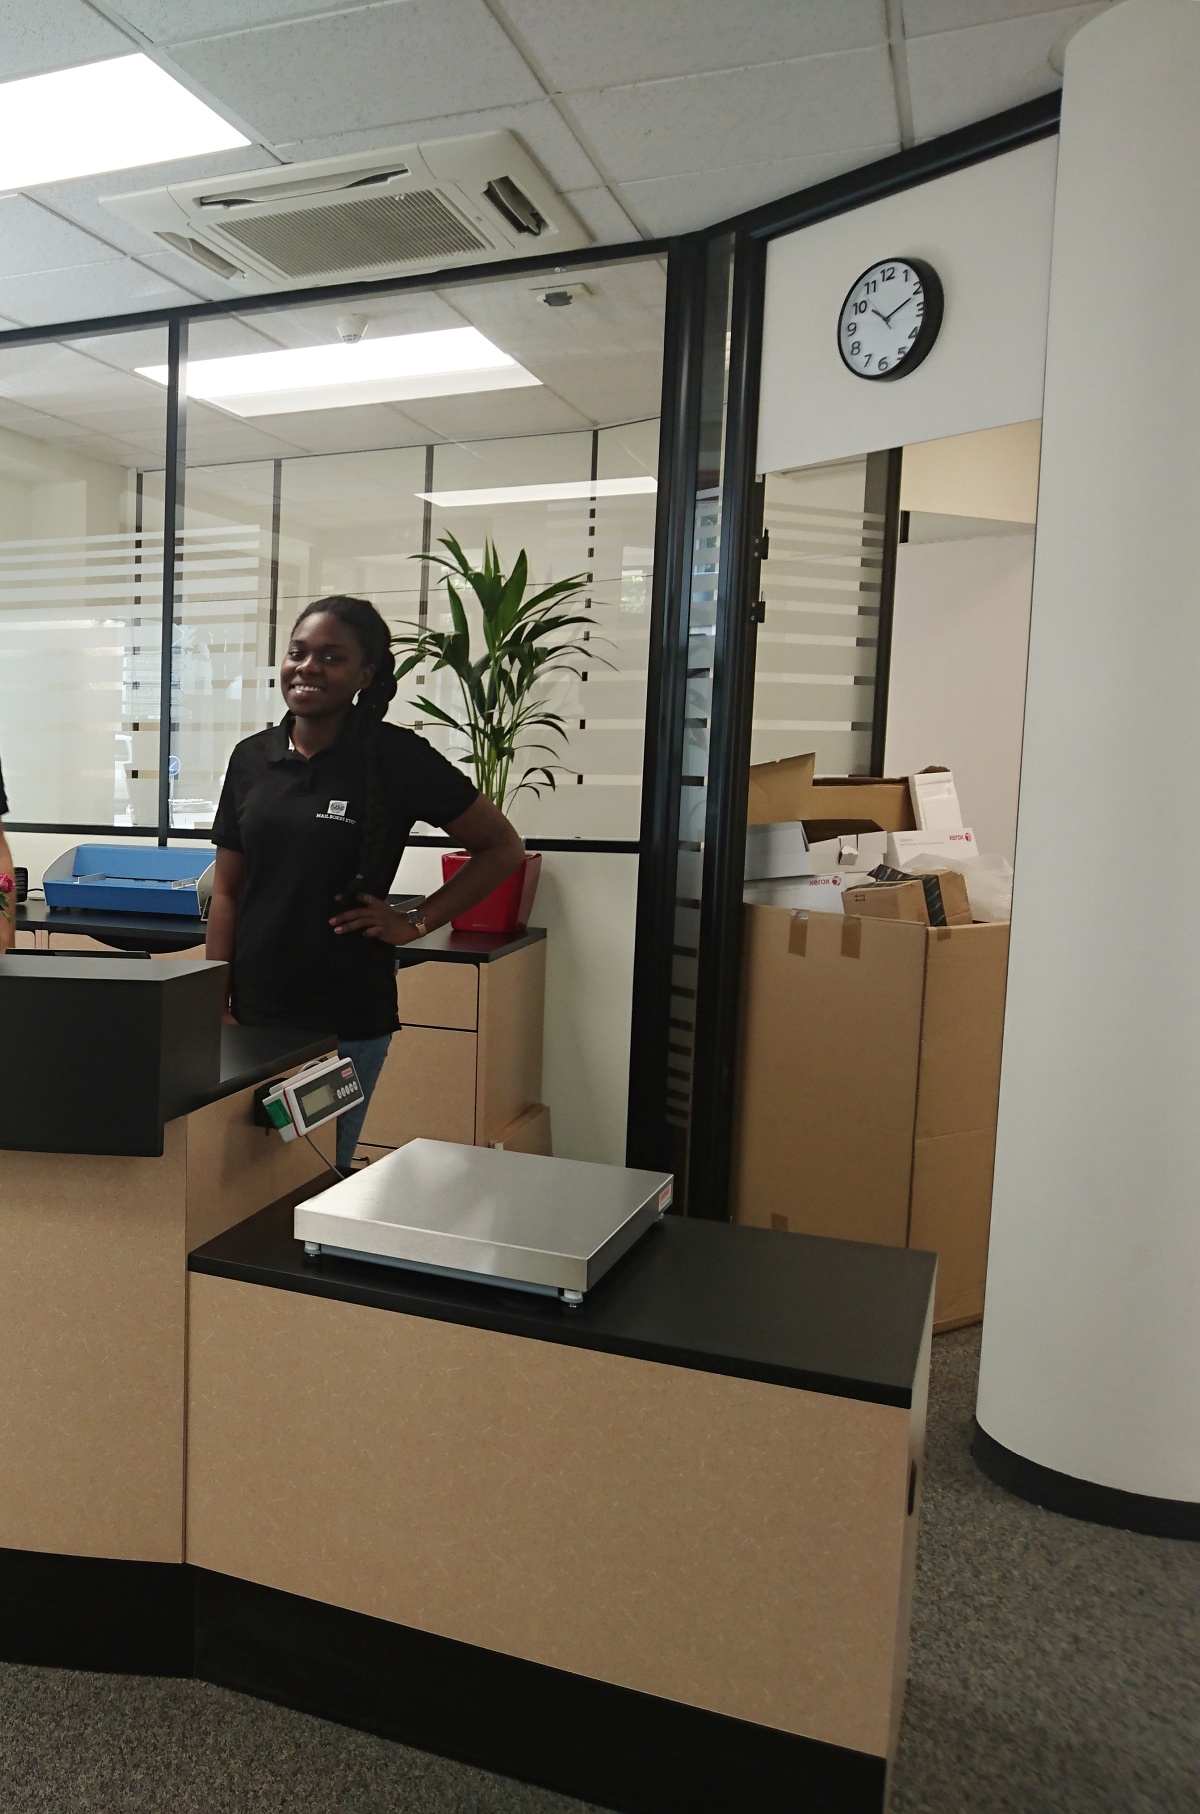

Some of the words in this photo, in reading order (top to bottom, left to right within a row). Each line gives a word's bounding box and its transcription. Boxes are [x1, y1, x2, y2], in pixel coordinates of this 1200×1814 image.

[880, 267, 895, 282] 12
[903, 269, 909, 282] 1
[864, 280, 877, 295] 11
[913, 281, 922, 295] 2
[852, 300, 867, 315] 10
[916, 302, 924, 317] 3
[847, 322, 857, 337] 9
[908, 326, 919, 339] 4
[850, 341, 861, 355] 8
[897, 346, 907, 360] 5
[864, 354, 872, 367] 7
[878, 357, 888, 371] 6
[809, 878, 830, 886] xerox
